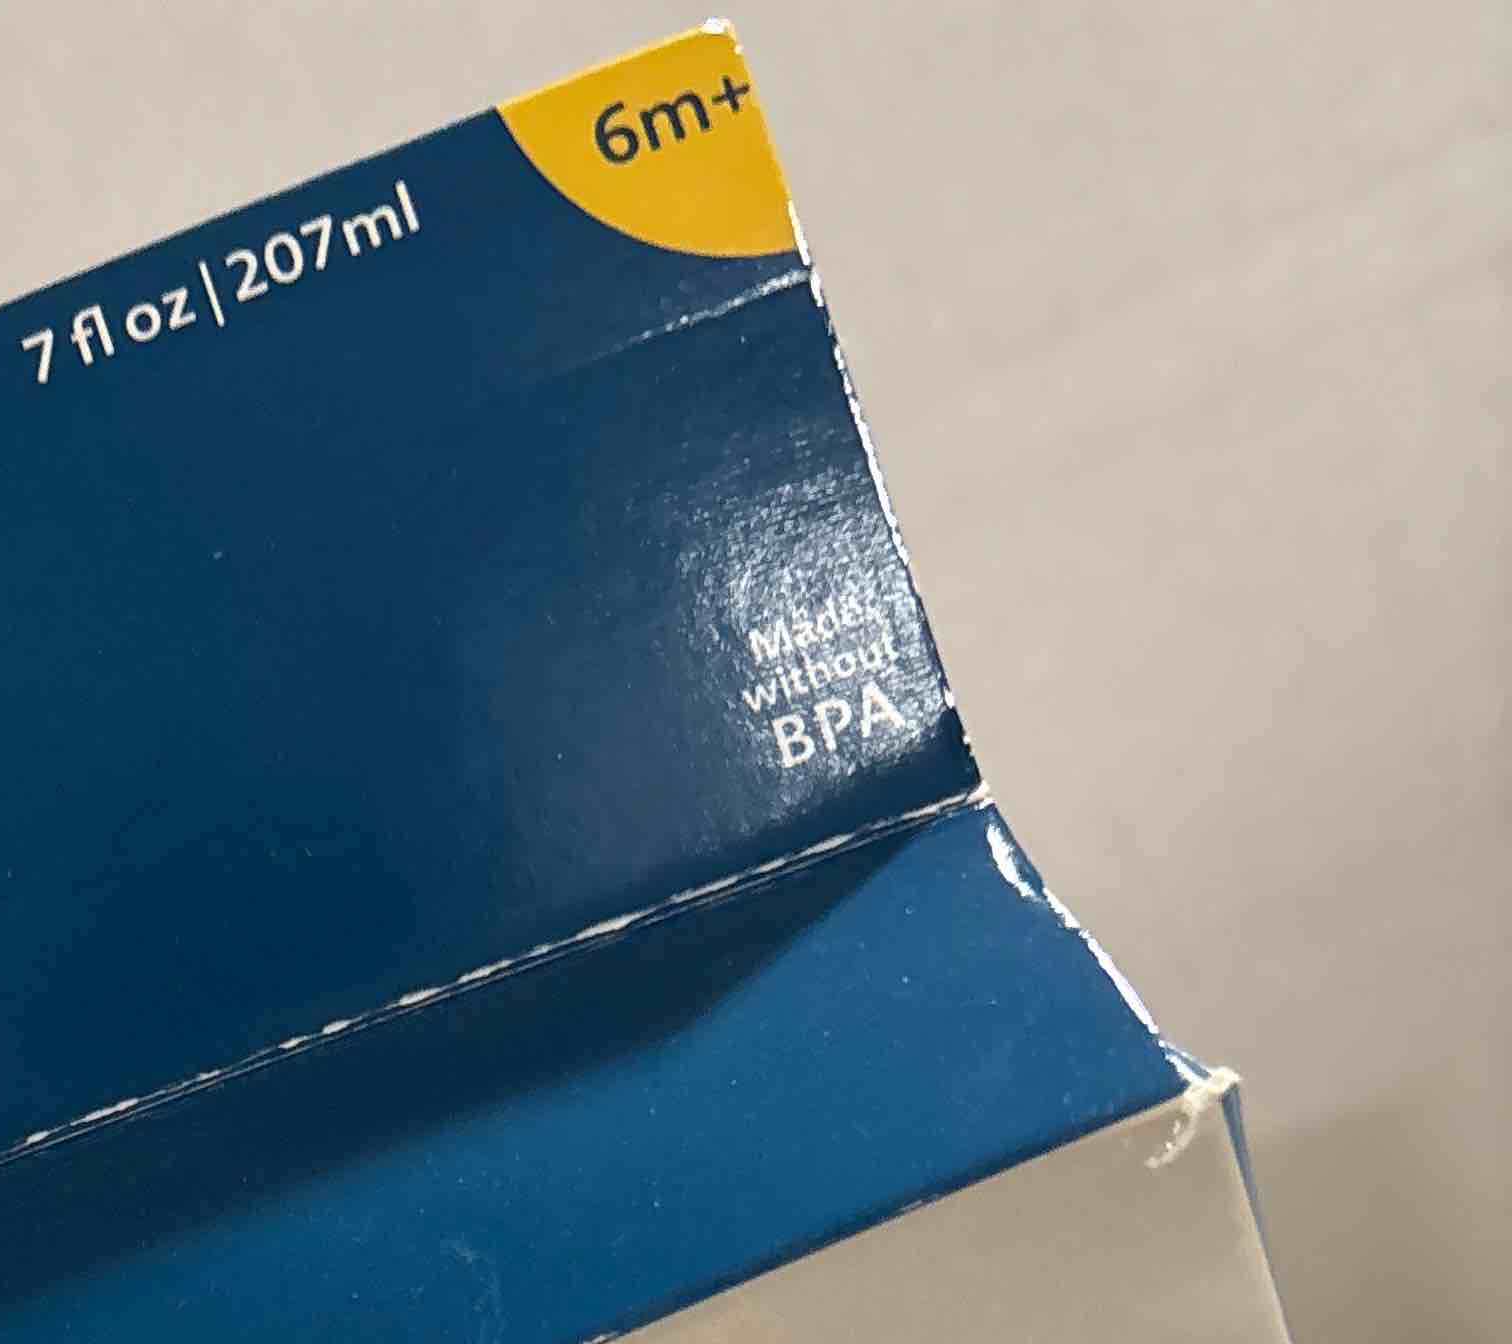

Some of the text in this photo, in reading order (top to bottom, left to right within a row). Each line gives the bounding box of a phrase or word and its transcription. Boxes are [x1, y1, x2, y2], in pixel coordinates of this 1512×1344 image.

[593, 74, 751, 165] 6m+
[20, 327, 55, 385] 7
[69, 303, 116, 366] fl
[742, 630, 899, 713] without
[747, 594, 876, 666] Made
[771, 680, 906, 769] BPA
